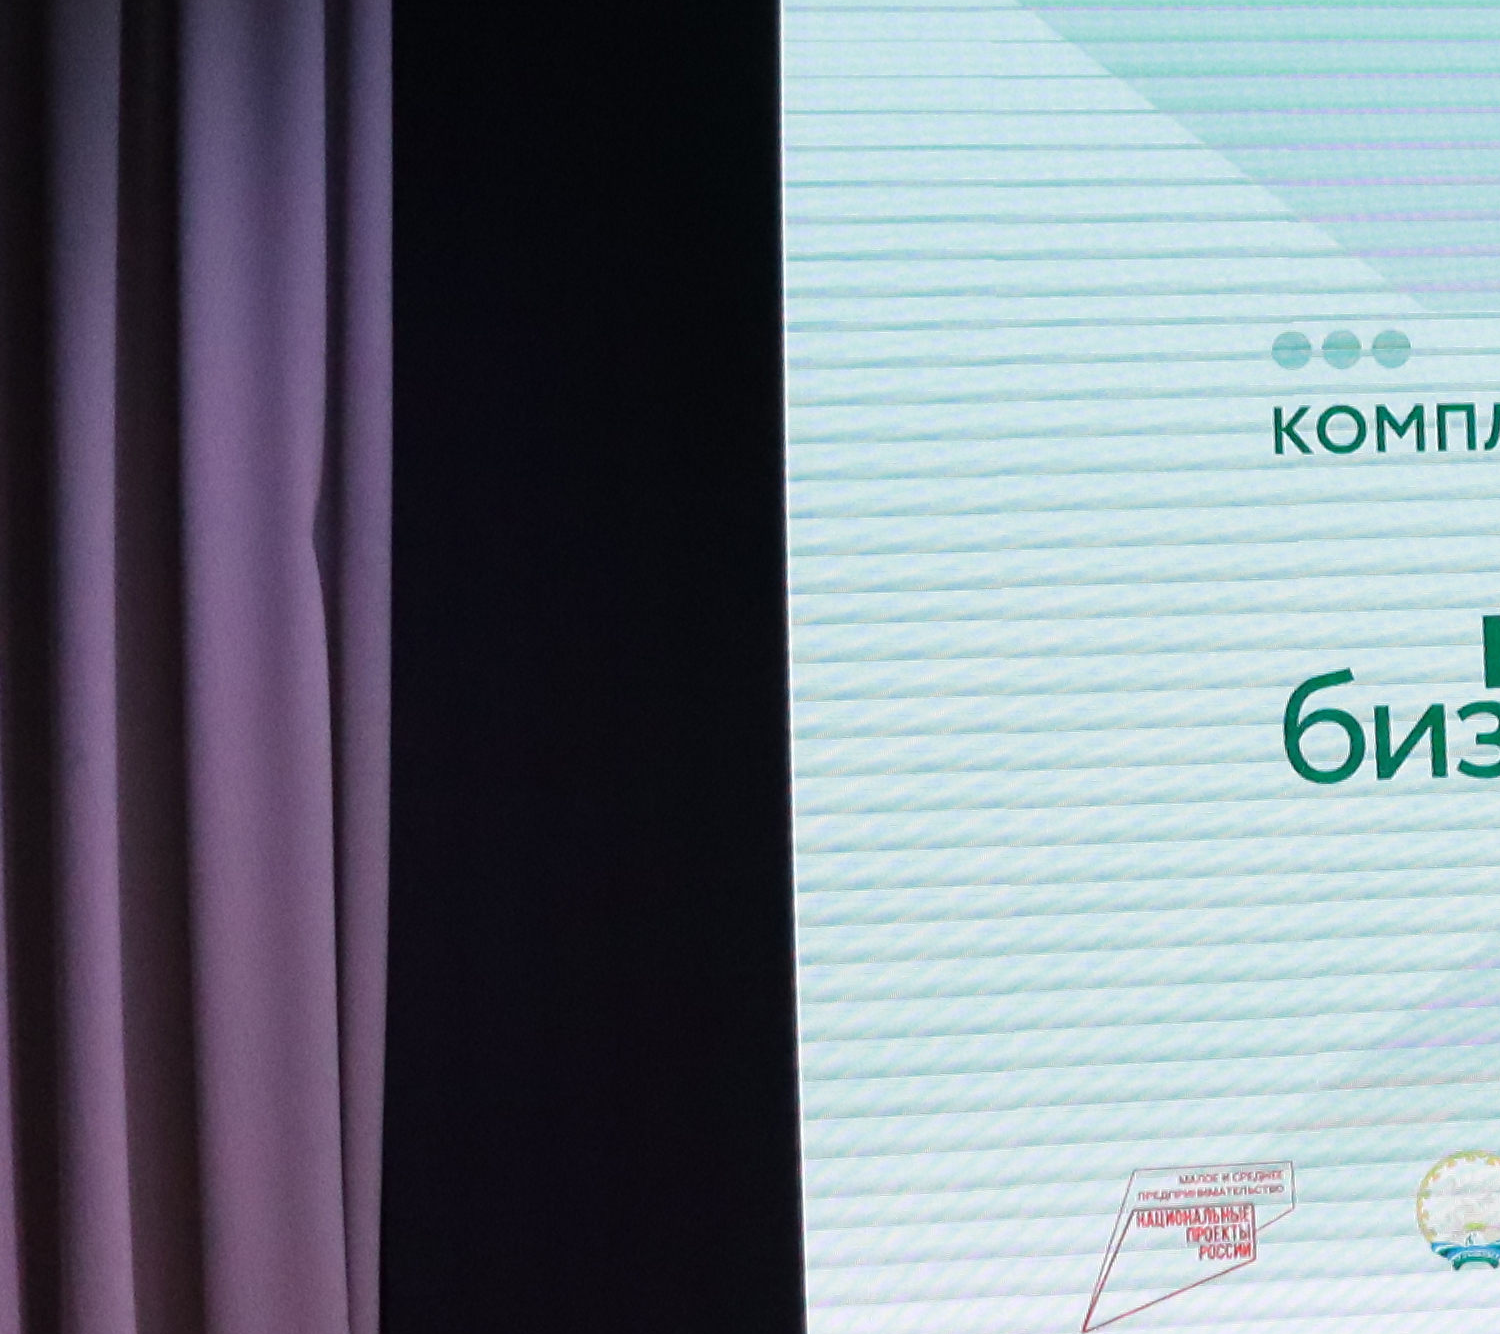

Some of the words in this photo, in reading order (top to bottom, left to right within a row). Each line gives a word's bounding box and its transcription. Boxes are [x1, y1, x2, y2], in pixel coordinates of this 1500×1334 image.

[1137, 1205, 1250, 1228] НАЦИОНАЛЬНЫЕ
[1186, 1224, 1250, 1242] ПРОЕКТЫ
[1199, 1243, 1252, 1260] РОССИИ
